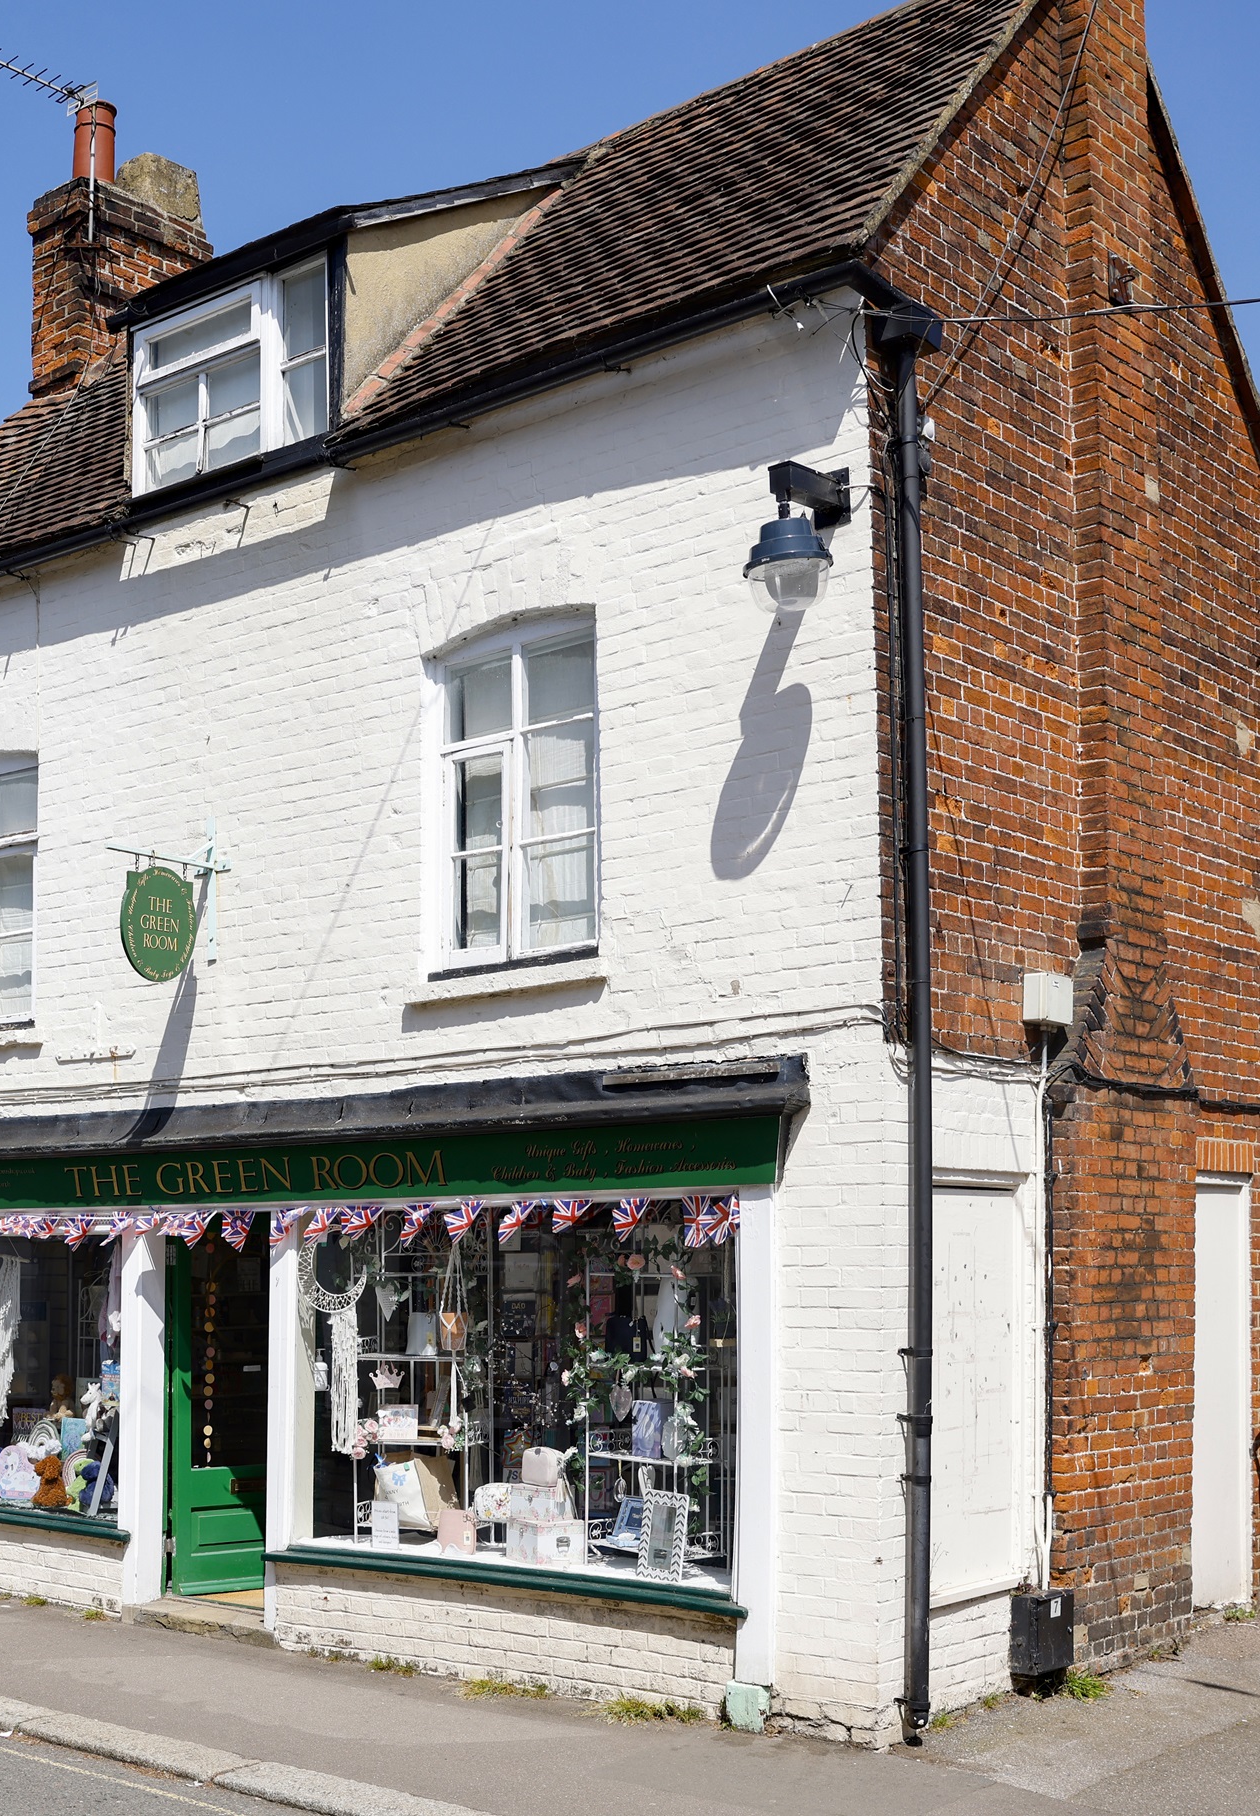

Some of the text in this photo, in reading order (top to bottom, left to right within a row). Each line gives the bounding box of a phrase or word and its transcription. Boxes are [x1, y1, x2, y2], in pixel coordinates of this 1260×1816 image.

[148, 895, 173, 914] THE
[140, 914, 180, 933] GREEN
[143, 933, 178, 952] ROOM
[524, 1144, 567, 1163] Unique
[614, 1137, 684, 1153] Homewares
[64, 1150, 449, 1198] THE GREEN ROOM
[491, 1165, 541, 1181] Children
[545, 1163, 556, 1182] &
[614, 1159, 665, 1176] Fashion
[669, 1156, 737, 1172] Accessories
[21, 1412, 42, 1423] BEST
[1053, 1600, 1059, 1614] 7
